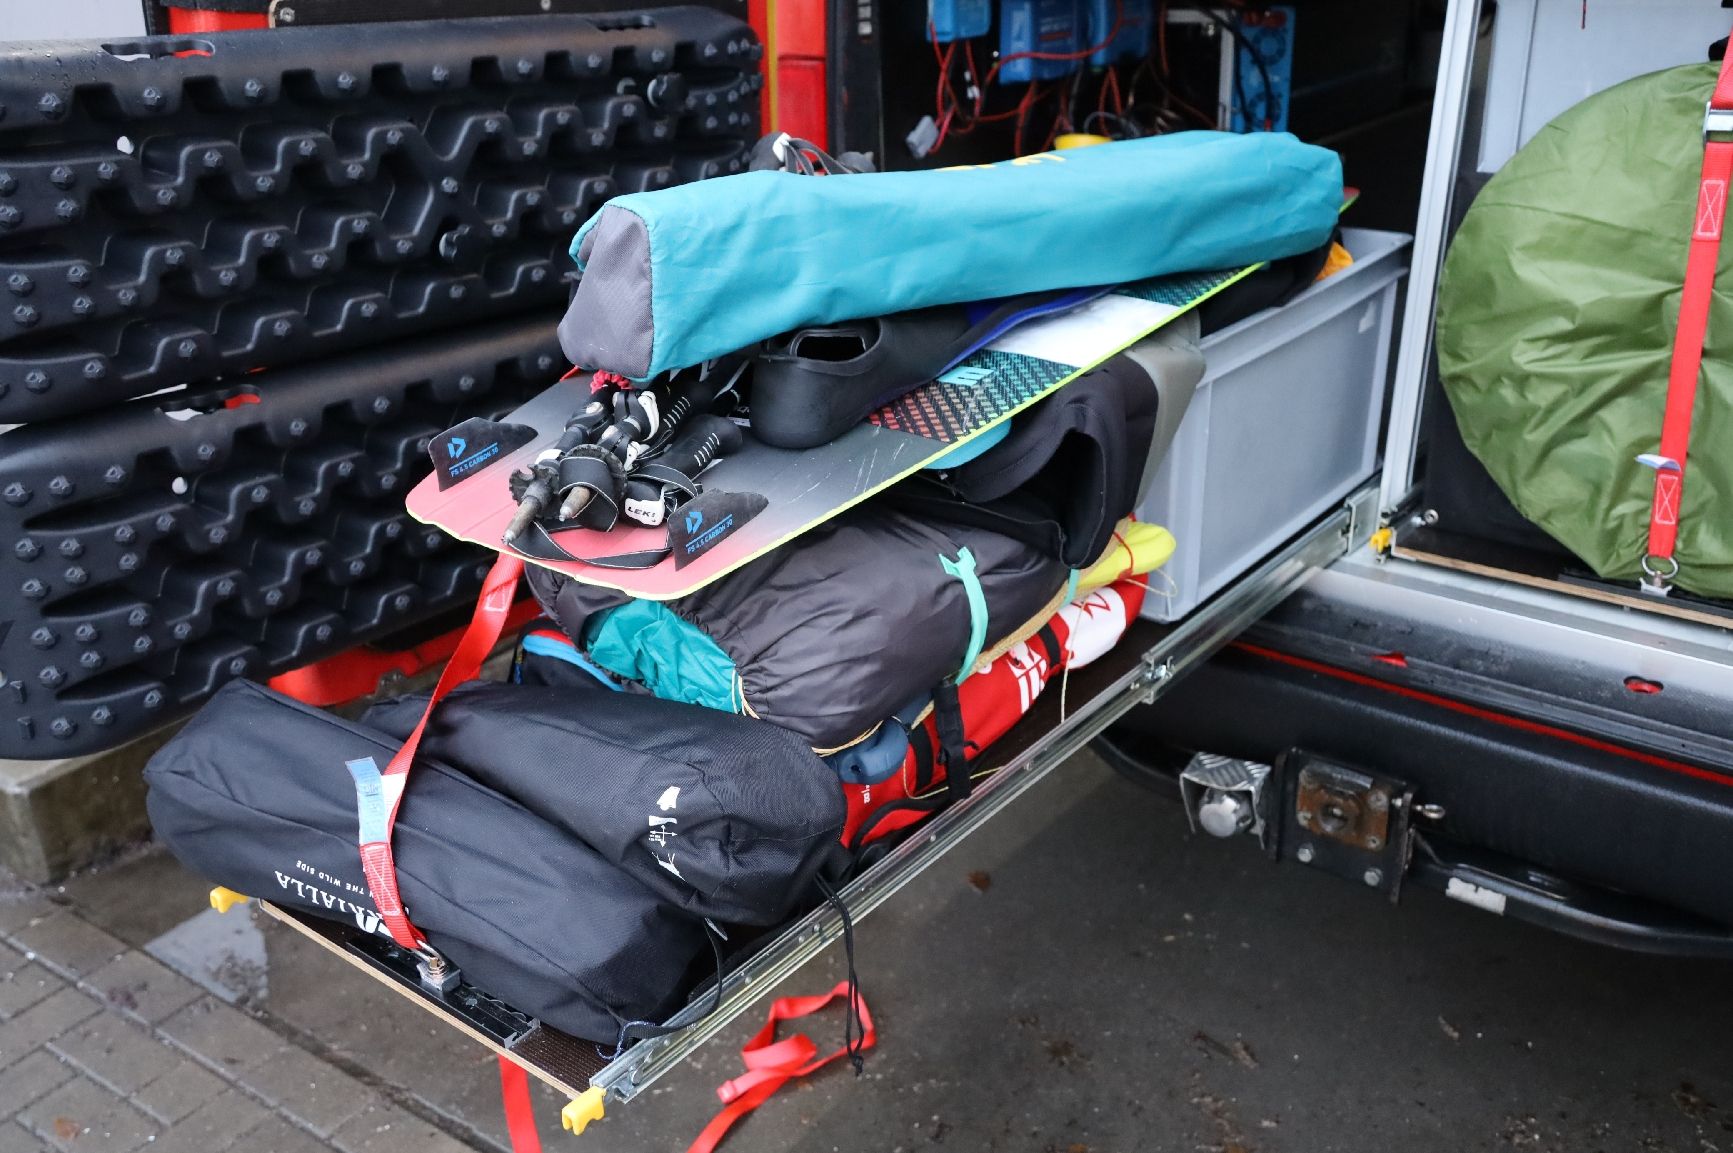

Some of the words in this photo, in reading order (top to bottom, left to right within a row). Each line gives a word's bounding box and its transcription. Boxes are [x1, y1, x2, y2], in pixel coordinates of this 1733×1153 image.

[450, 468, 460, 478] FS
[468, 450, 492, 468] CARBON
[627, 506, 656, 518] LEKI
[687, 545, 696, 555] FS
[704, 523, 726, 543] CARBON
[295, 859, 315, 875] SIDE
[318, 871, 341, 887] WILD
[345, 882, 365, 895] THE
